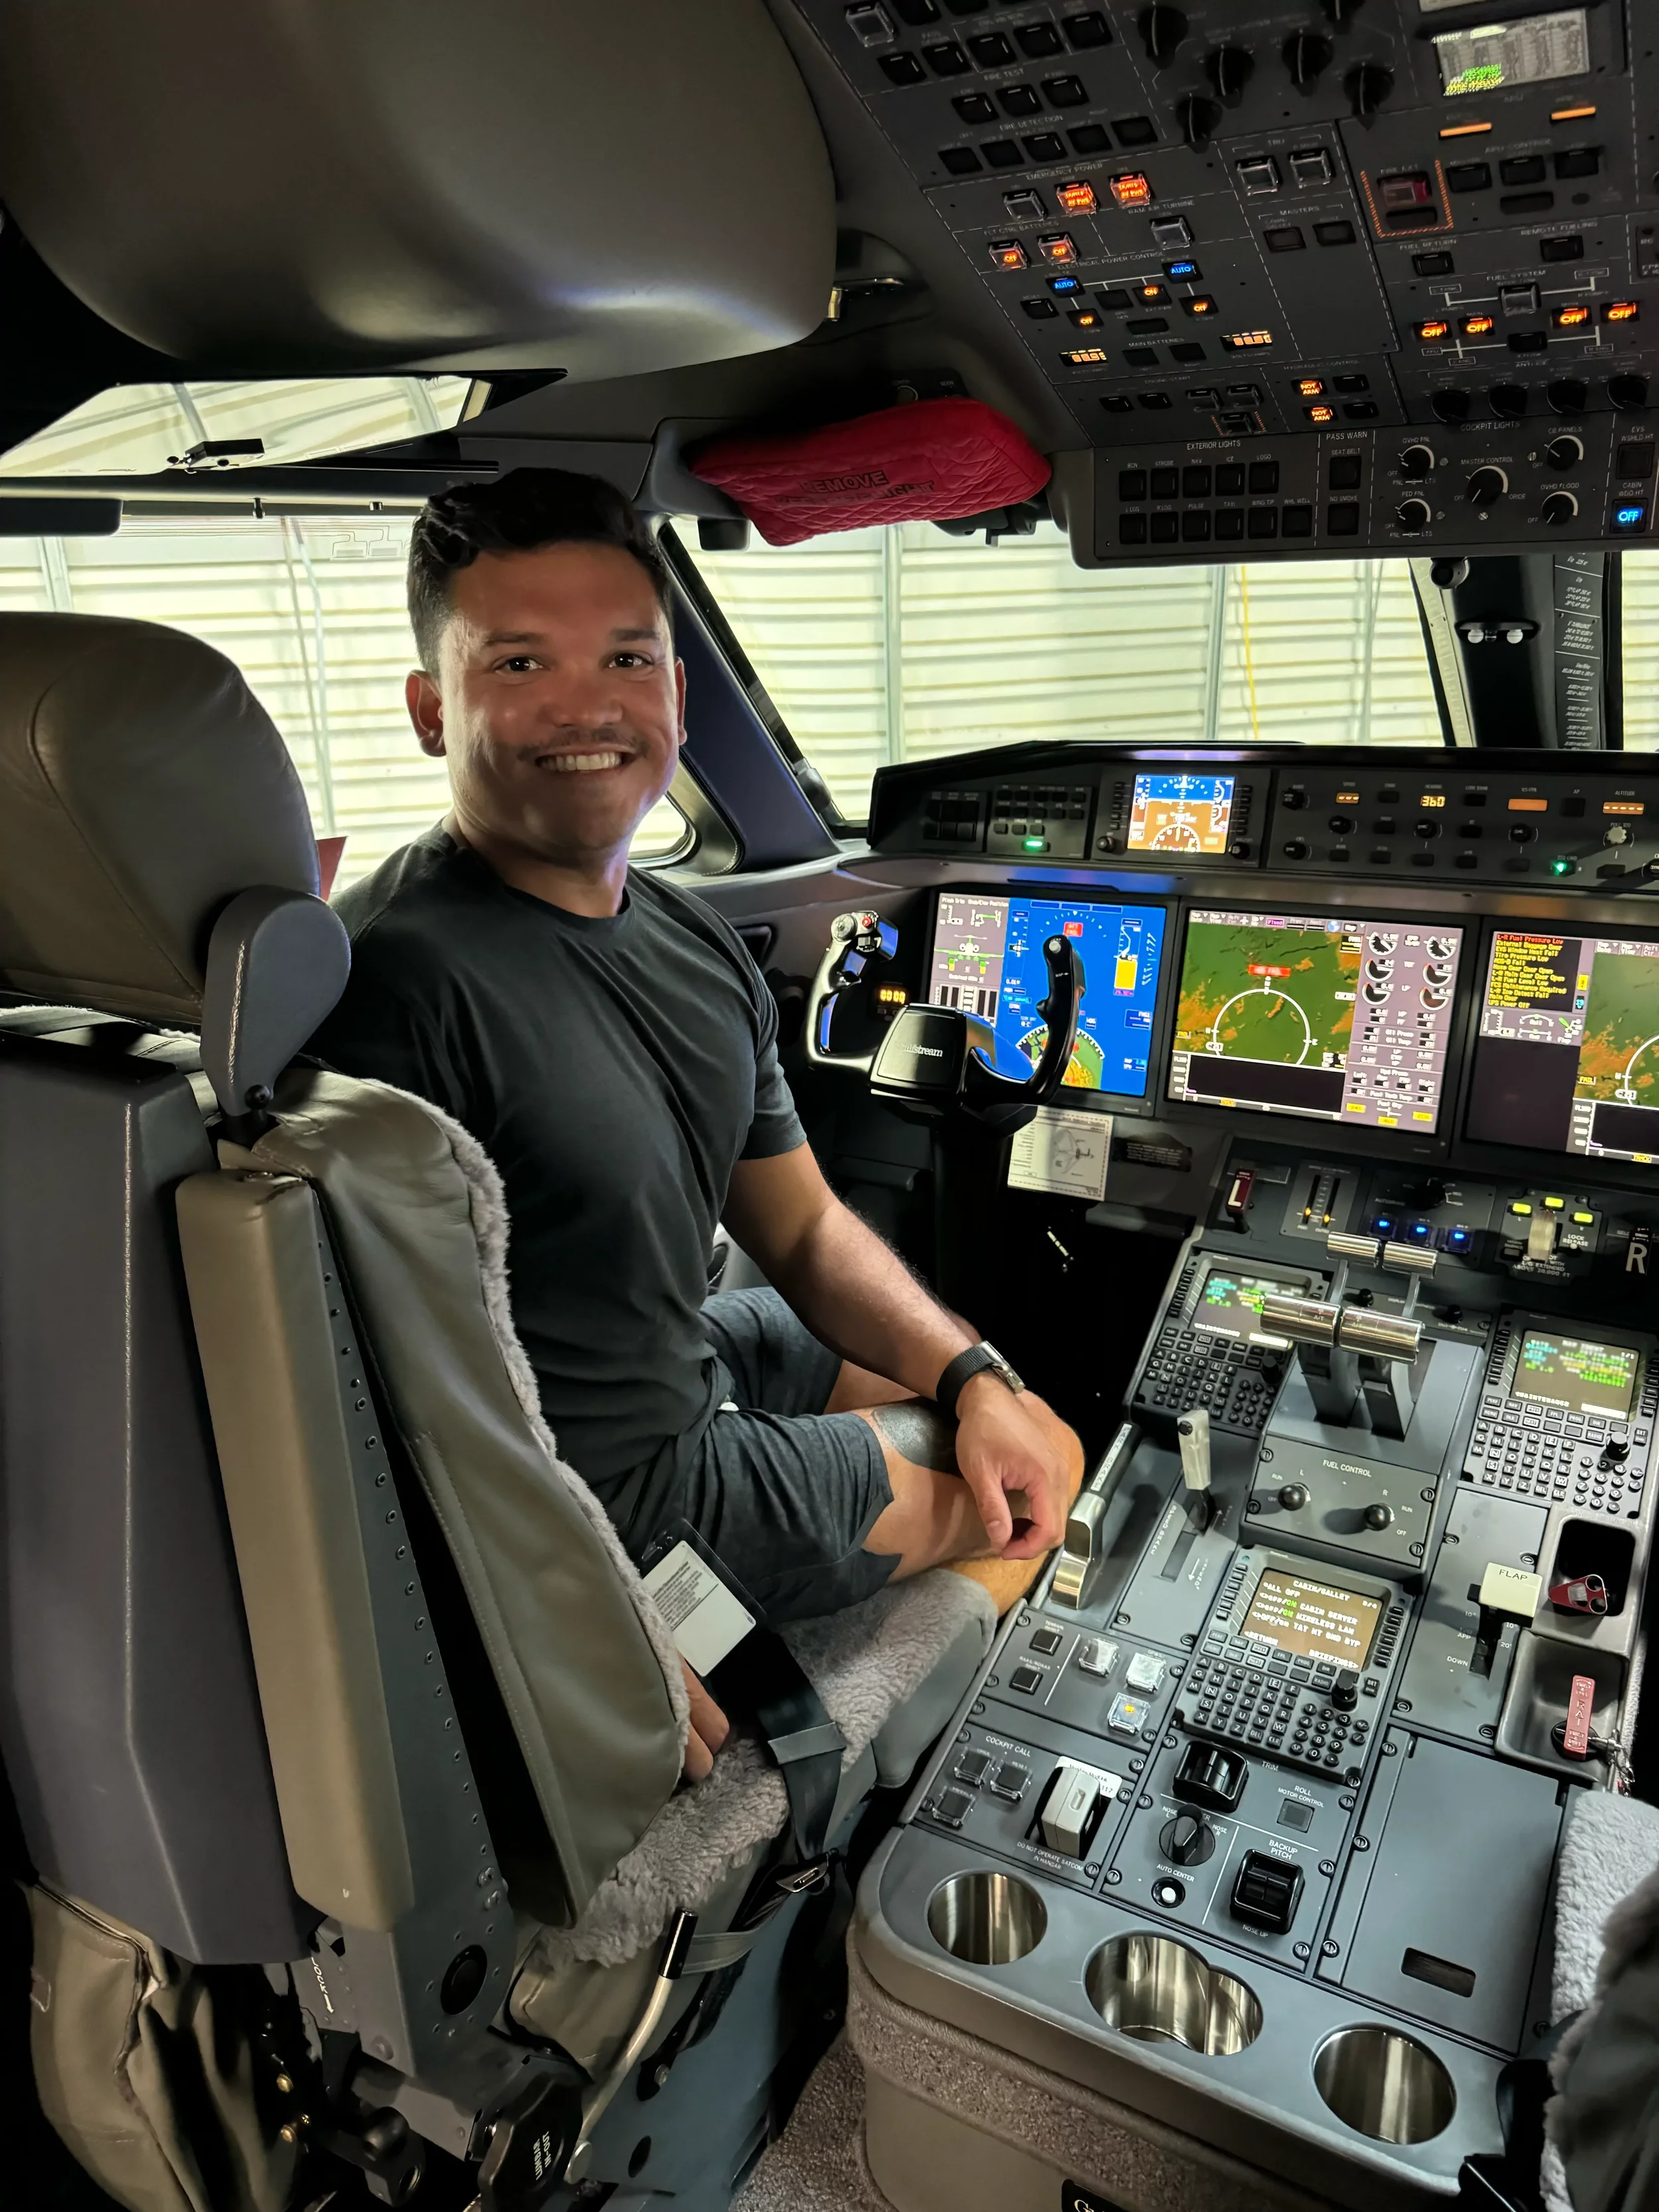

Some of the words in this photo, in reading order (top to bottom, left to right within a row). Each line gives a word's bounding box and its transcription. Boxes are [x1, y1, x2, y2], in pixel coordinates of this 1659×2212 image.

[983, 71, 1002, 81] FIRE
[1003, 68, 1025, 79] TEST
[999, 122, 1017, 131] FIRE
[1017, 115, 1064, 128] DETECTION
[1027, 167, 1073, 181] EMERGENCY
[1074, 163, 1104, 174] POWER
[1144, 205, 1160, 214] AIR
[1162, 200, 1195, 212] TURBINE
[1279, 206, 1320, 216] MASTERS
[1521, 226, 1558, 235] REMOTE
[1003, 253, 1017, 263] OFF
[1052, 246, 1068, 257] OFF
[1058, 259, 1100, 270] ELECTRICAL
[1101, 256, 1129, 265] POWER
[1130, 251, 1166, 262] CONTROL
[1170, 265, 1193, 274] AUTO
[1509, 269, 1546, 279] SYSTEM
[1054, 280, 1074, 289] AUTO
[1144, 286, 1159, 296] ON
[1193, 301, 1209, 313] OFF
[1079, 315, 1094, 326] OFF
[1559, 314, 1582, 325] OFF
[1609, 309, 1632, 319] OFF
[1421, 328, 1443, 338] OFF
[1466, 323, 1488, 333] OFF
[1460, 423, 1491, 431] COCKPIT
[1494, 420, 1520, 429] LIGHTS
[1187, 441, 1216, 450] EXTERIOR
[1218, 439, 1240, 449] LIGHTS
[1619, 511, 1638, 522] OFF
[1227, 1179, 1242, 1207] L
[1626, 1241, 1648, 1274] R
[1323, 1459, 1339, 1470] FUEL
[1340, 1463, 1372, 1477] CONTROL
[1498, 1569, 1528, 1581] FLAP
[1293, 1580, 1350, 1601] CABIN/GALLEY
[1299, 1602, 1325, 1615] CABIN
[1328, 1609, 1358, 1625] SERVER
[1296, 1612, 1336, 1630] WIRELESS
[1338, 1624, 1354, 1636] LAN
[1293, 1622, 1309, 1632] TAT
[1311, 1627, 1322, 1637] HT
[1344, 1637, 1361, 1648] BYP
[1309, 1649, 1359, 1669] BRIEFINGS>
[1447, 1655, 1469, 1666] DOWN
[1575, 1700, 1585, 1726] RAT
[985, 1735, 1013, 1751] COCKPIT
[1015, 1745, 1032, 1758] CALL
[1262, 1761, 1279, 1771] TRIM
[1278, 1787, 1299, 1800] MOTOR
[1298, 1795, 1325, 1808] CONTROL
[1294, 1785, 1311, 1797] ROLL
[1162, 1805, 1177, 1816] NOSE
[1212, 1824, 1228, 1834] NOSE
[1269, 1839, 1298, 1855] BACKUP
[1271, 1847, 1292, 1860] PITCH
[1025, 1844, 1037, 1852] NOT
[1037, 1848, 1060, 1862] OPERATE
[1060, 1857, 1083, 1872] SATCOM
[1041, 1857, 1062, 1871] HANGAR
[1157, 1864, 1173, 1874] AUTO
[1173, 1869, 1195, 1882] CENTER
[1242, 1924, 1260, 1935] NOSE
[1260, 1930, 1268, 1939] UP
[311, 1956, 328, 1994] LOCK
[542, 2130, 552, 2168] IN-OUT
[533, 2137, 543, 2181] LUMBAR
